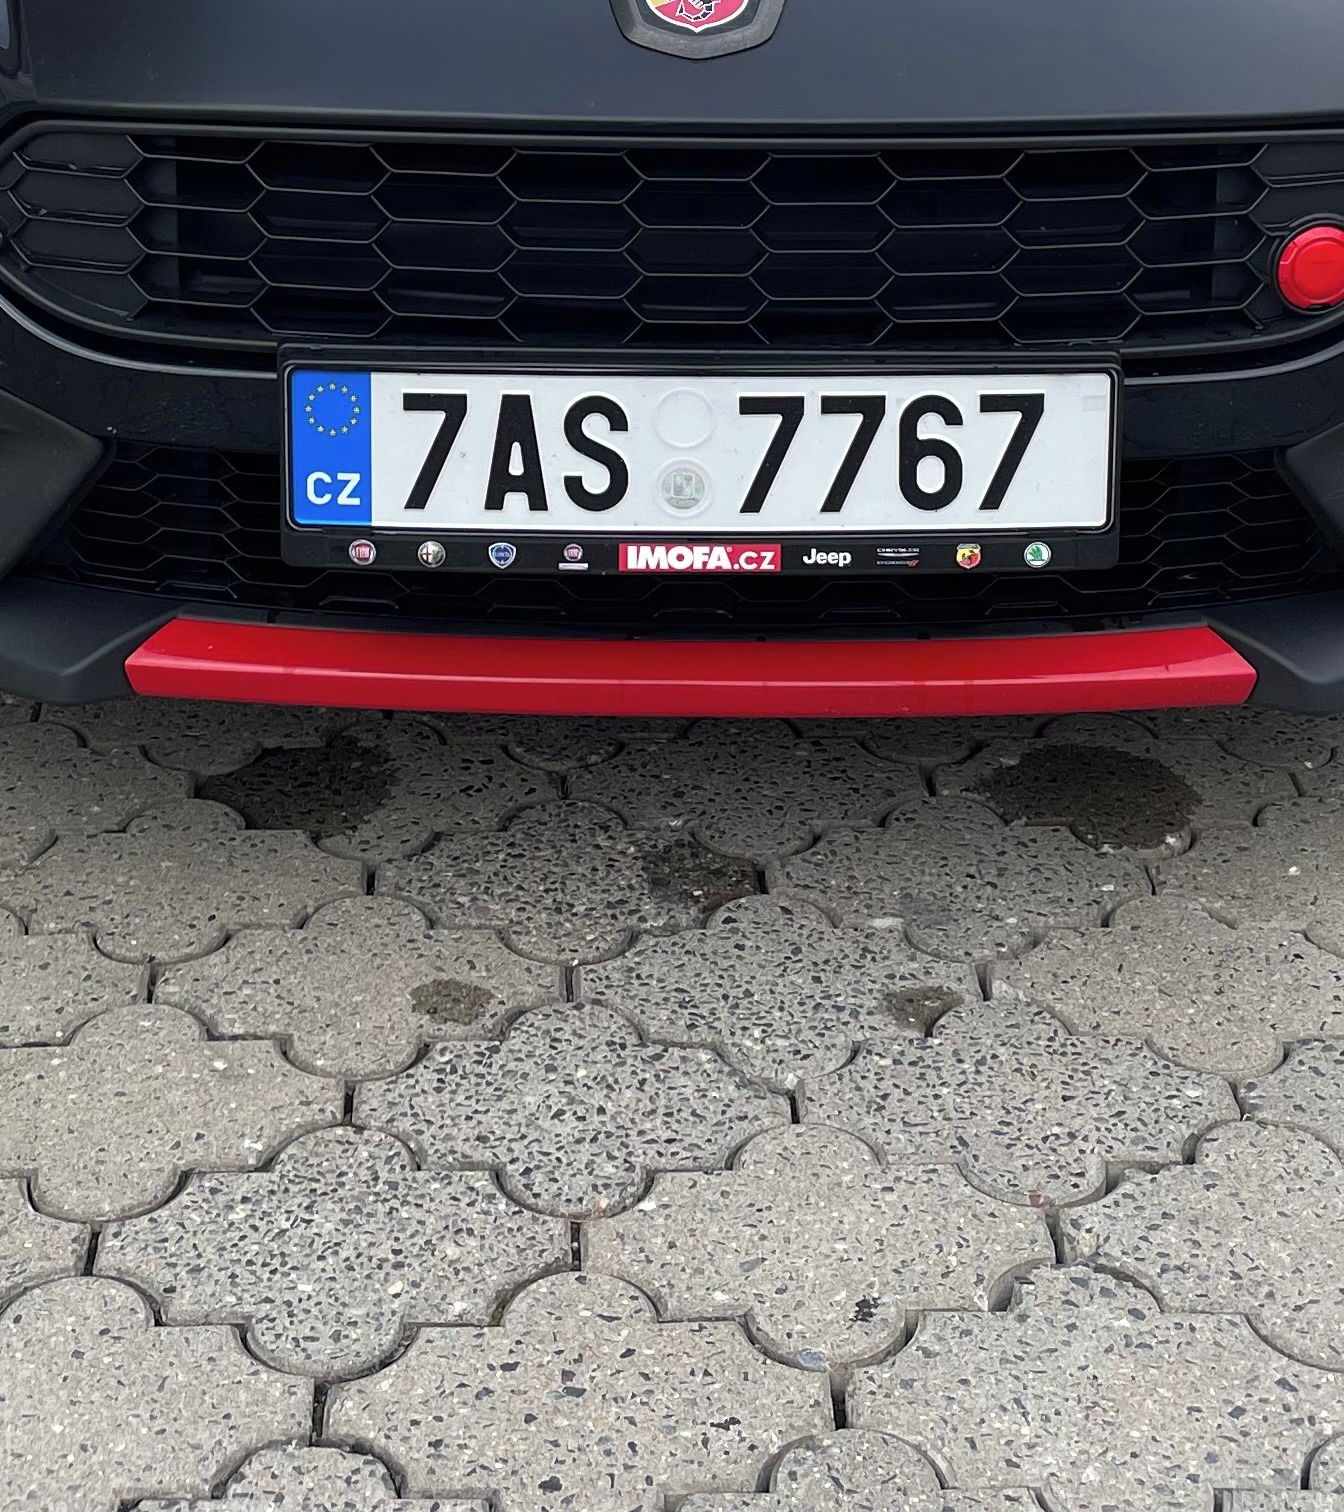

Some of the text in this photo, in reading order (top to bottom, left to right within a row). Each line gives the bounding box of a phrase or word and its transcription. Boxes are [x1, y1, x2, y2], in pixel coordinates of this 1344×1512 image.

[402, 392, 1046, 514] 7AS 7767
[306, 471, 361, 506] CZ
[802, 547, 852, 568] Jeep
